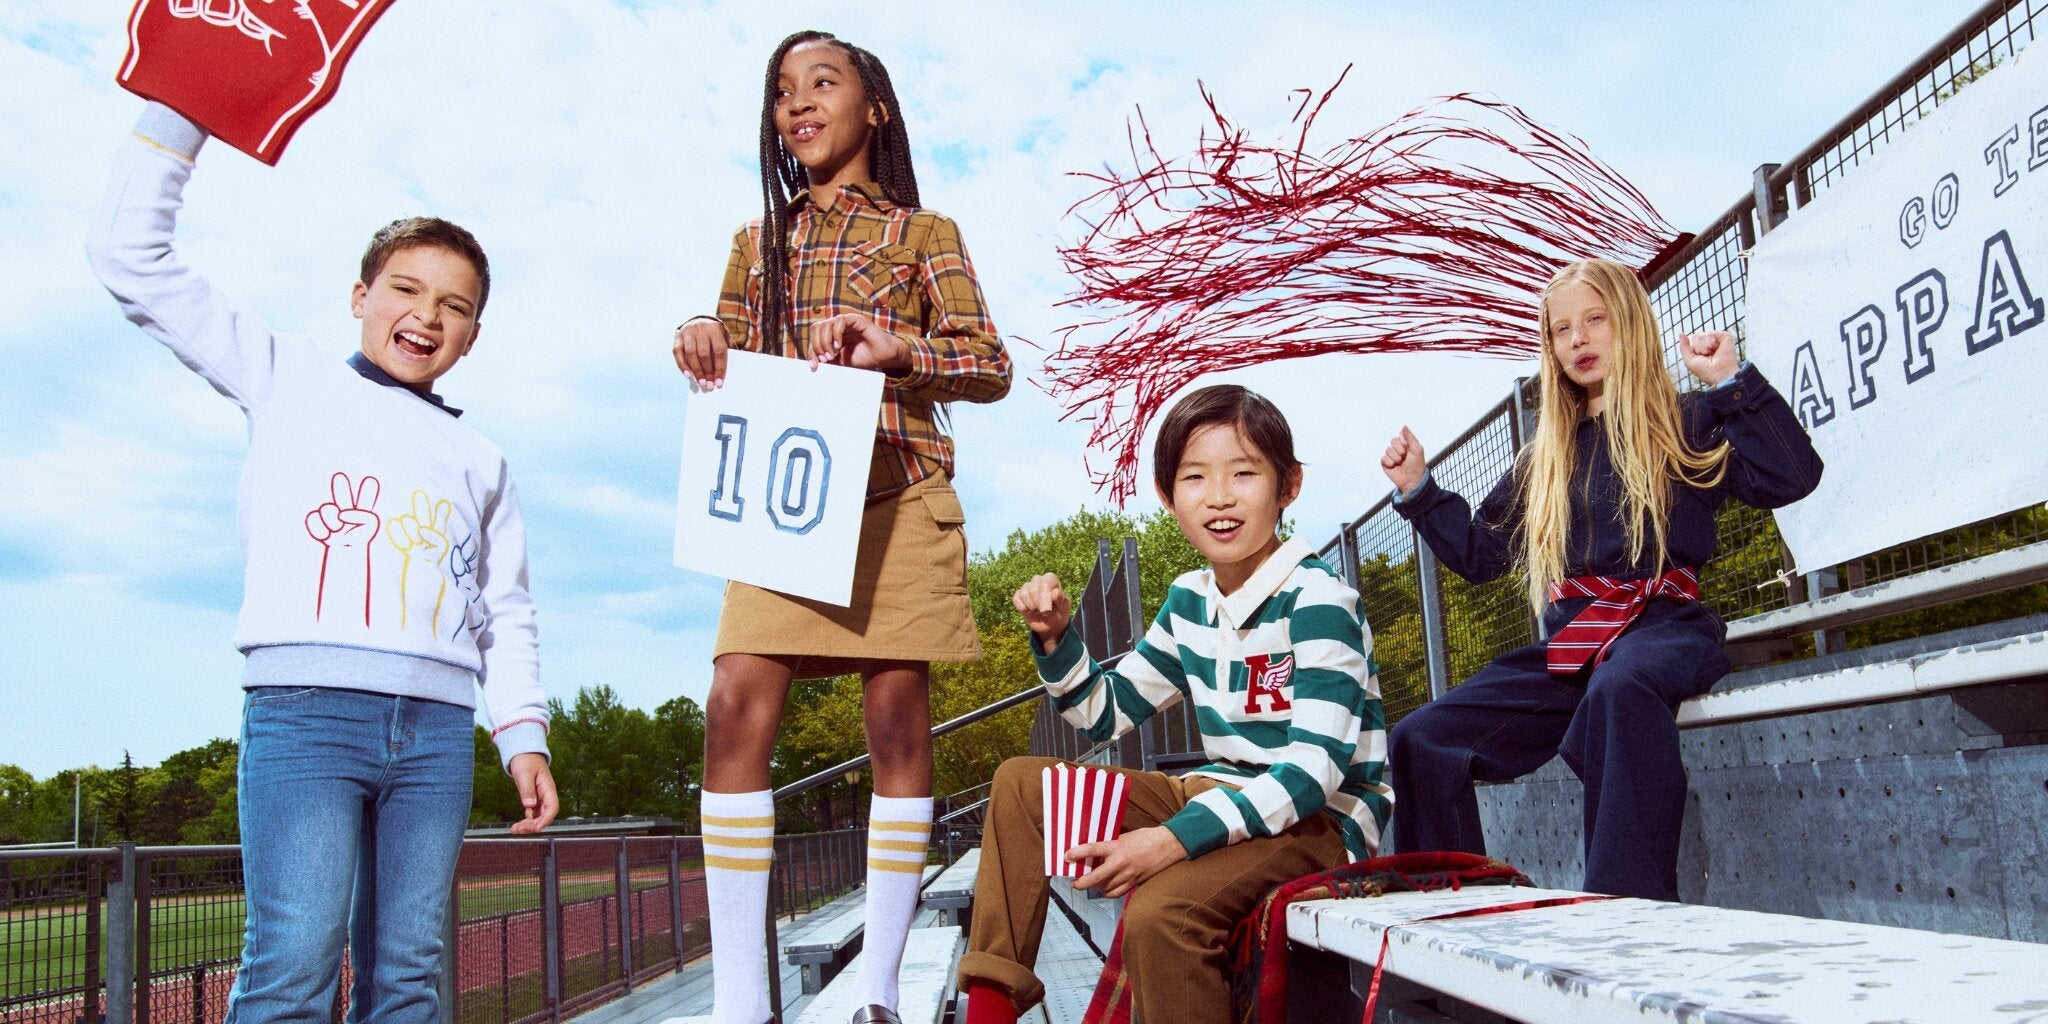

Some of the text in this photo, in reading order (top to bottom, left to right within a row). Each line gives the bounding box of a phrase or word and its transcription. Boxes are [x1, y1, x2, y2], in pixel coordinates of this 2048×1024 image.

[1899, 172, 1959, 249] GO
[709, 414, 832, 535] 10
[1244, 654, 1292, 715] A
